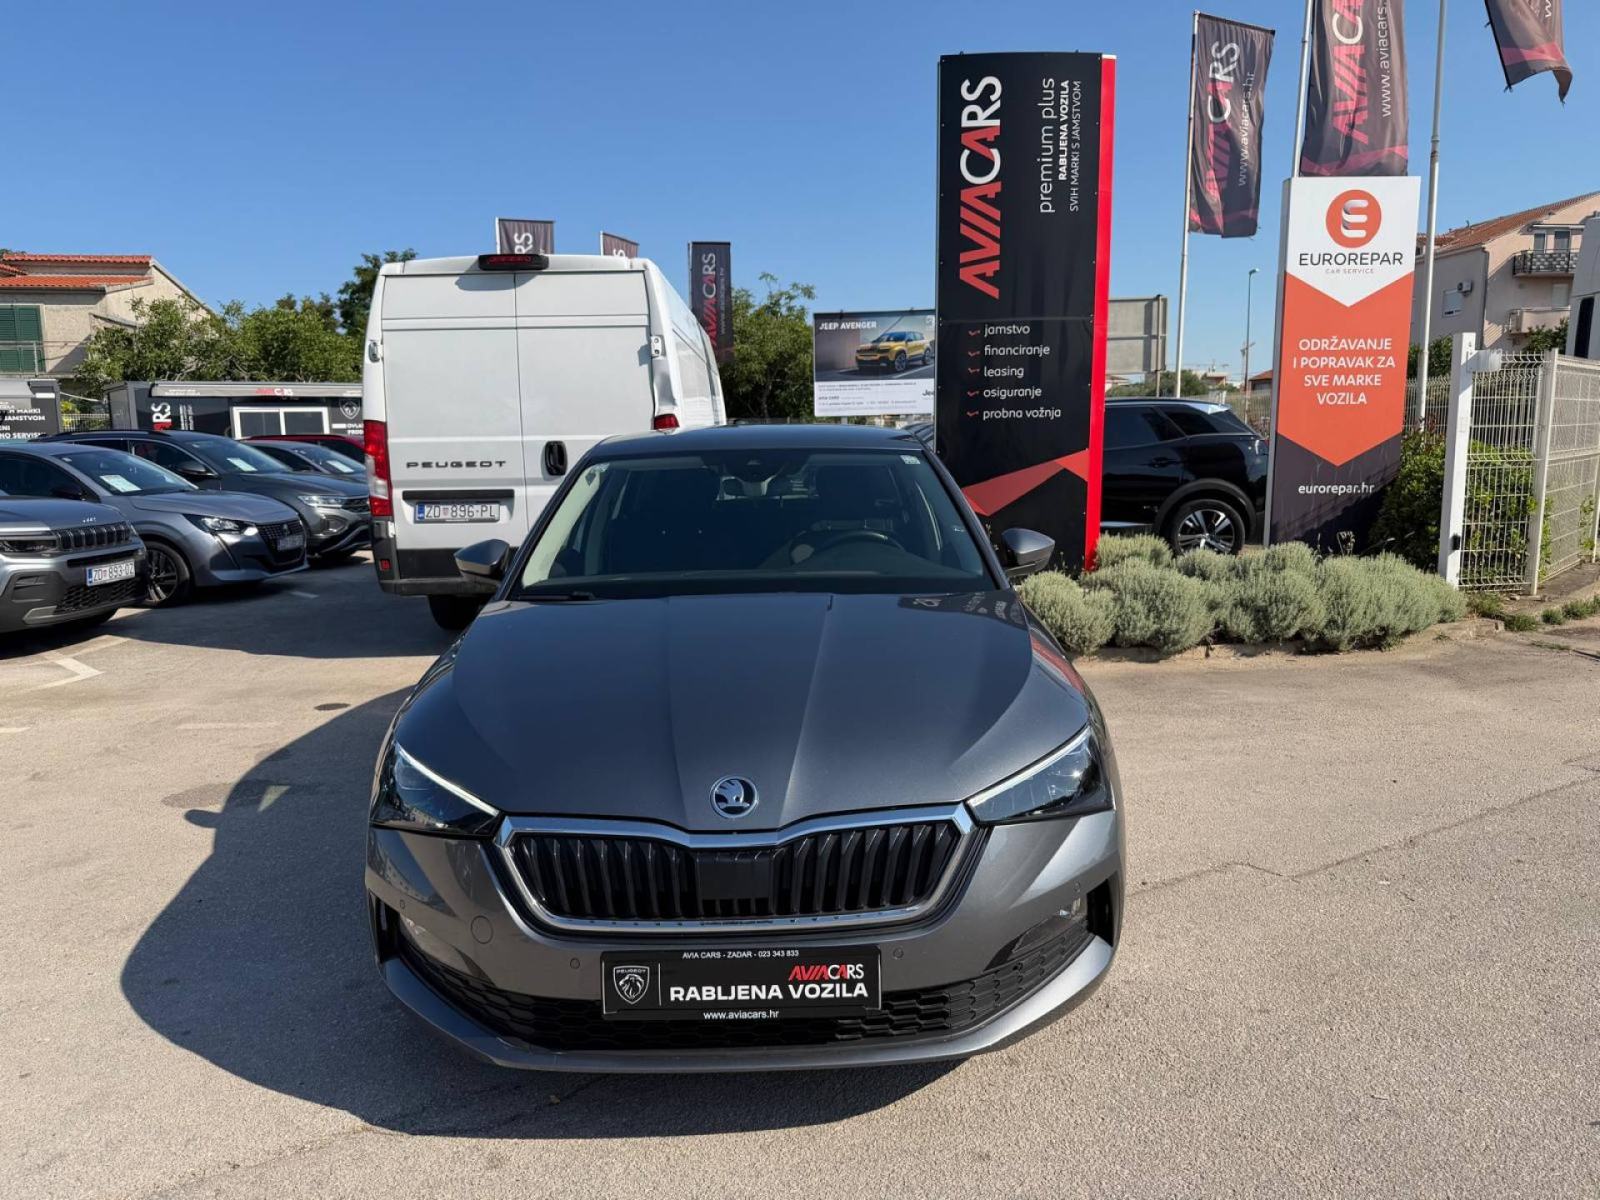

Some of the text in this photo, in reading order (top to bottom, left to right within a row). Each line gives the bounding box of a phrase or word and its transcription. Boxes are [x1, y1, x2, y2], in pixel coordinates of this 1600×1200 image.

[1071, 80, 1082, 141] JAMSTVOM
[1058, 80, 1069, 181] RABLJENA VOZILA
[1036, 78, 1057, 213] premium plus
[1070, 151, 1080, 185] MARKI
[959, 75, 1003, 299] AVIACARS
[1069, 187, 1080, 212] SVIH
[1299, 252, 1404, 266] EUROREPAR
[819, 321, 877, 330] JEEP AVENGER
[983, 323, 1031, 337] jamstvo
[983, 344, 1050, 357] financiranje
[1298, 336, 1393, 351] ODRŽAVANJE
[1293, 356, 1396, 369] I POPRAVAK ZA
[983, 366, 1025, 379] leasing
[1304, 374, 1382, 387] SVE MARKE
[983, 386, 1042, 400] osiguranje
[1316, 392, 1368, 405] VOZILA
[982, 406, 1062, 421] probna vožnja
[406, 460, 507, 469] PEUGEOT
[1298, 482, 1375, 496] eurorepar.hr
[425, 504, 496, 518] ZD 896-PL
[700, 951, 721, 959] CARS
[727, 951, 752, 959] ZADAR
[758, 950, 772, 958] 023
[773, 950, 785, 958] 343
[786, 949, 799, 957] 833
[788, 963, 864, 981] AVIACARS
[669, 981, 869, 1002] RABLJENA VOZILA
[703, 1009, 779, 1020] www.aviacars.hr
